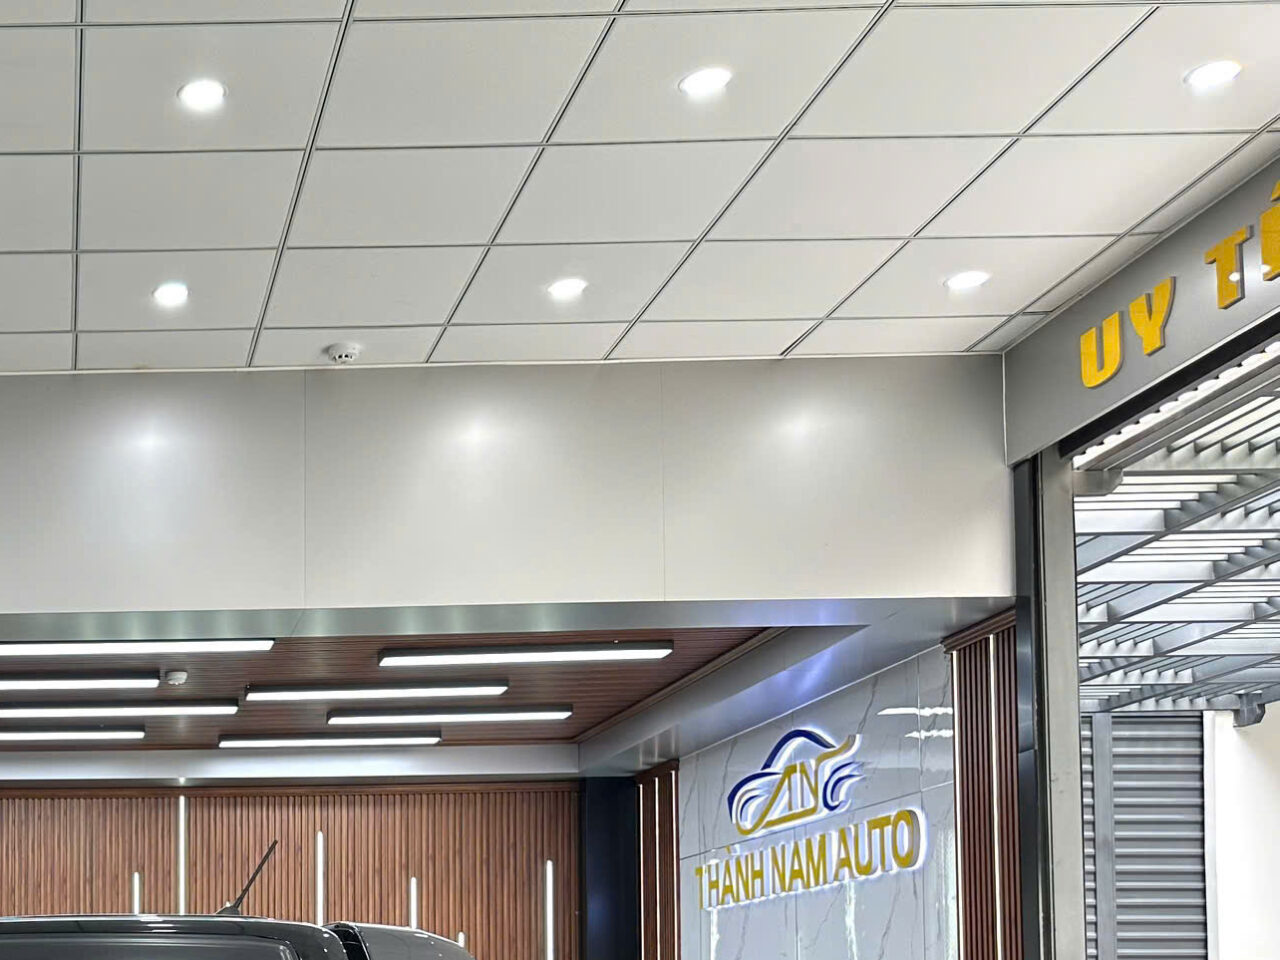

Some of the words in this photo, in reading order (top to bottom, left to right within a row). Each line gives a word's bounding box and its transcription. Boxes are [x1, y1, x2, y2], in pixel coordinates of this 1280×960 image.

[1080, 276, 1175, 388] UY
[695, 845, 766, 910] THÀNH
[771, 834, 829, 896] NAM
[833, 808, 918, 882] AUTO
